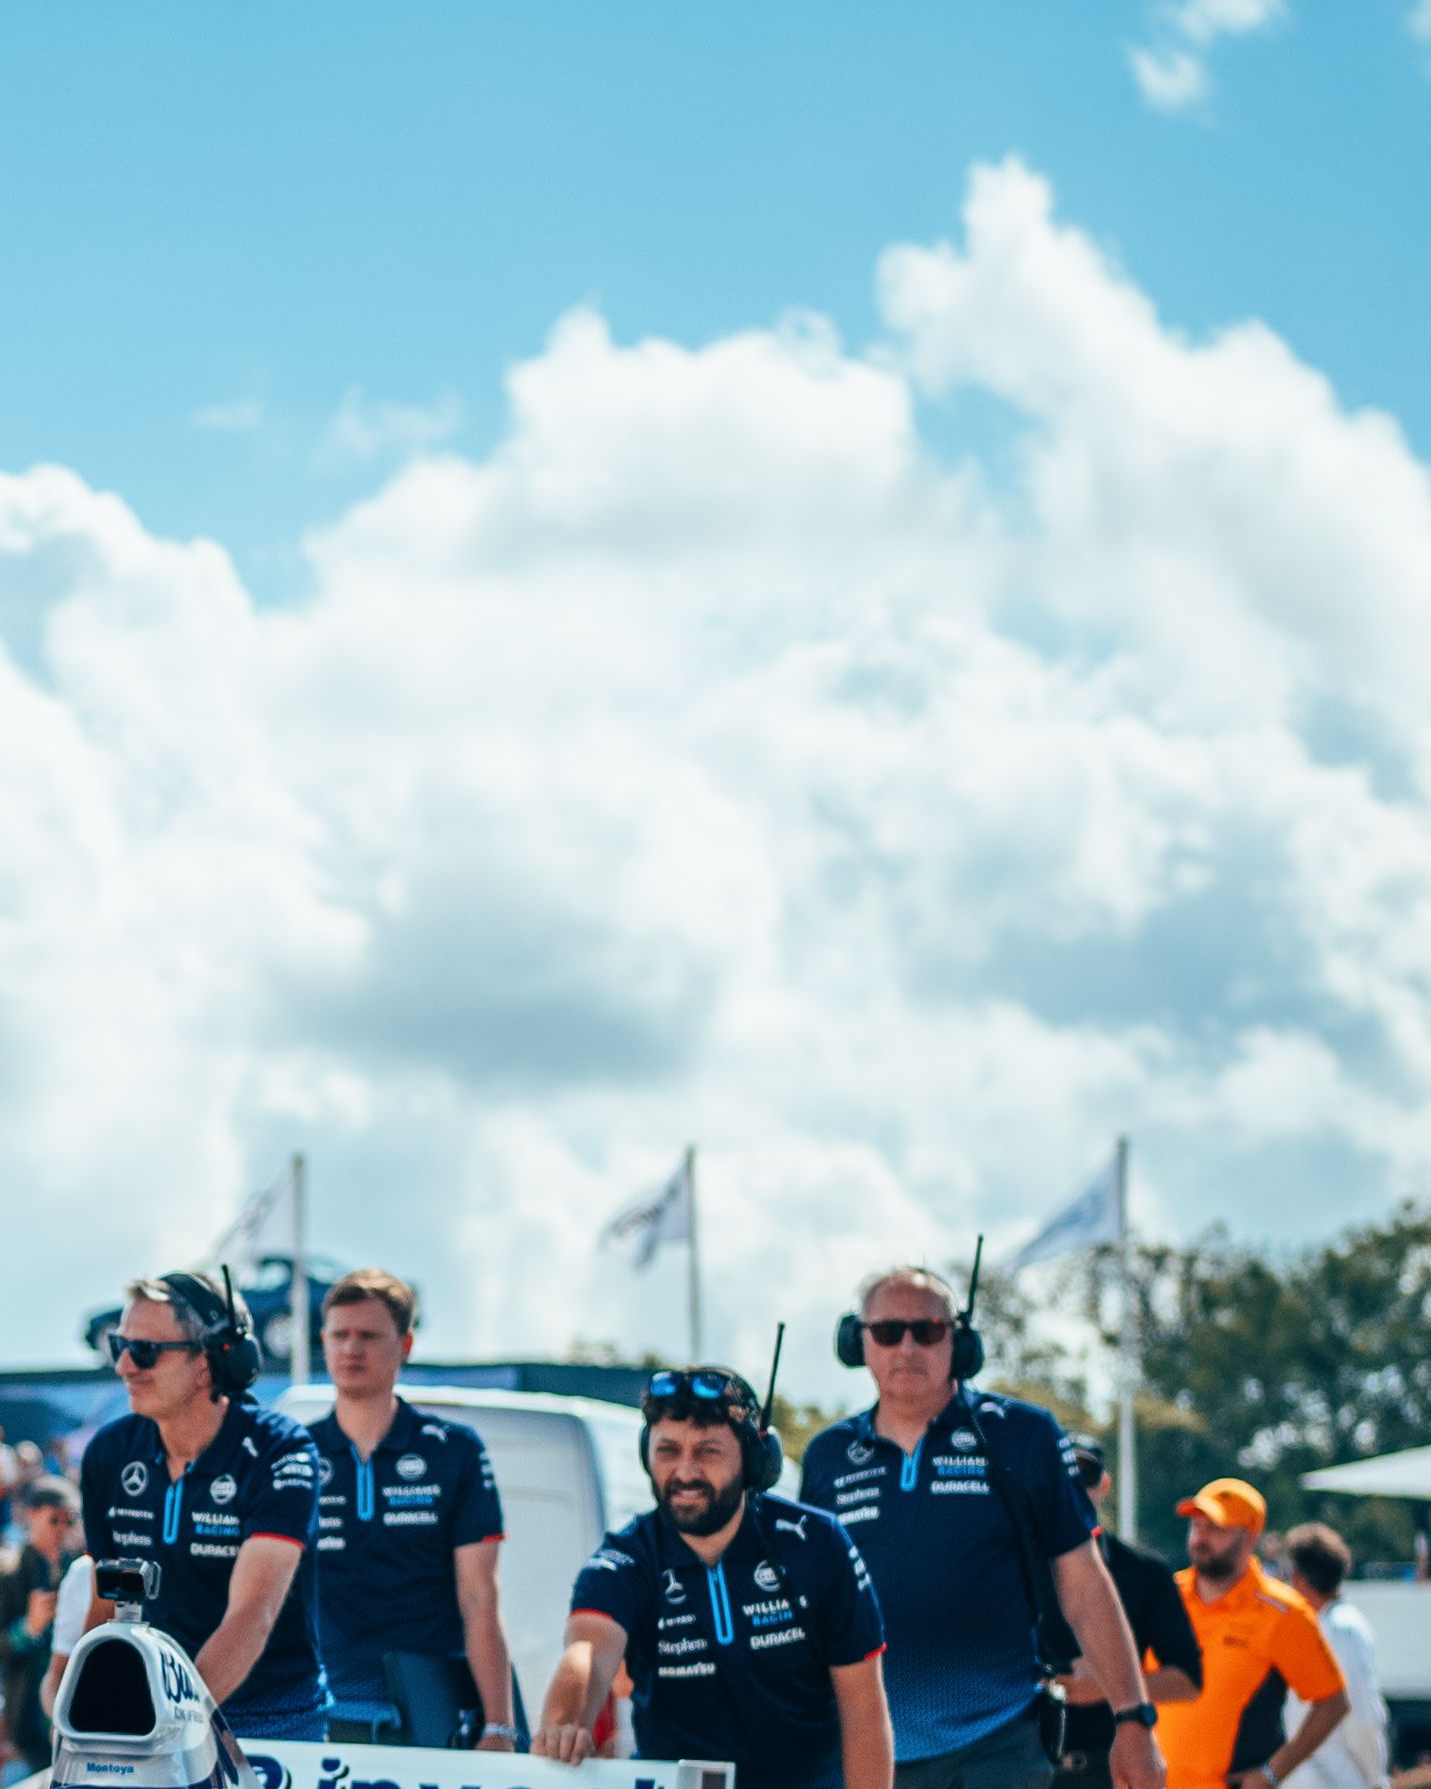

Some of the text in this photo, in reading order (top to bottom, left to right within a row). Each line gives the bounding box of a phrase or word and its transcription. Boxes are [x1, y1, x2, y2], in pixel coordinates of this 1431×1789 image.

[192, 1510, 240, 1526] WILLIAM
[743, 1595, 809, 1616] WILLIAS
[752, 1609, 794, 1627] RACIN
[750, 1627, 806, 1650] DURACEL
[87, 1762, 134, 1775] Montoya
